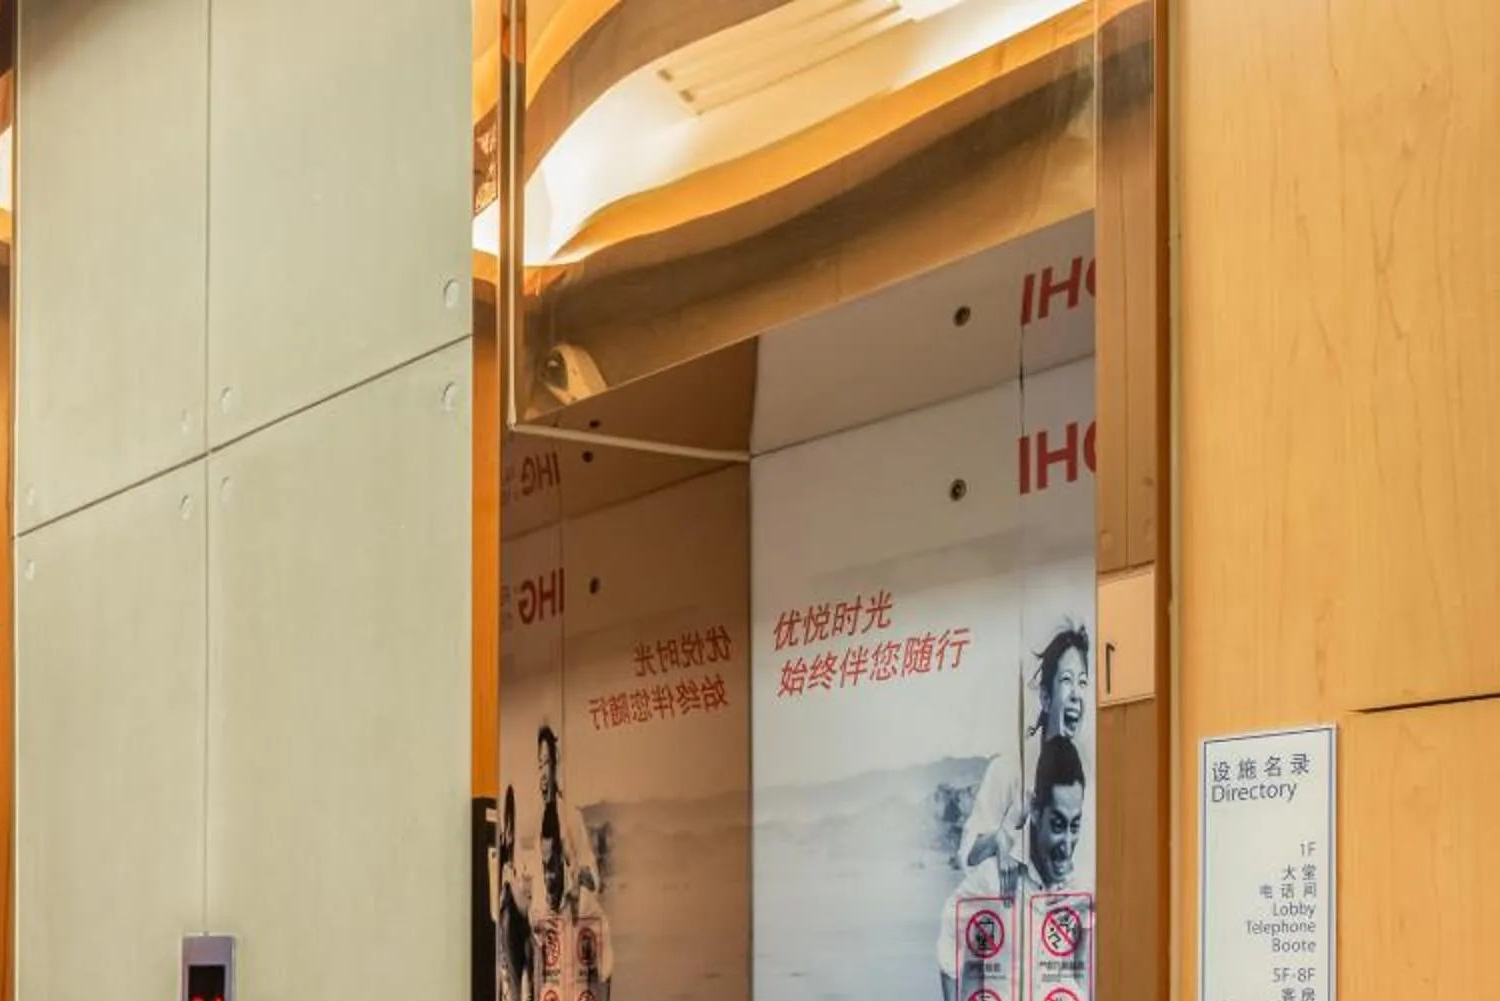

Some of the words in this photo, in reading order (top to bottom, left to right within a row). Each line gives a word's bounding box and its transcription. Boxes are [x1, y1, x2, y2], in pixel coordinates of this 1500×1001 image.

[773, 590, 893, 651] 优悦时光
[777, 627, 971, 698] 始终伴您随行
[1212, 753, 1310, 782] 设施名录
[1212, 783, 1297, 803] Directory
[1299, 842, 1316, 857] 1F
[1283, 864, 1316, 881] 大堂
[1259, 882, 1317, 899] 电话间
[1272, 902, 1316, 919] Lobby
[1246, 920, 1317, 936] Telephone
